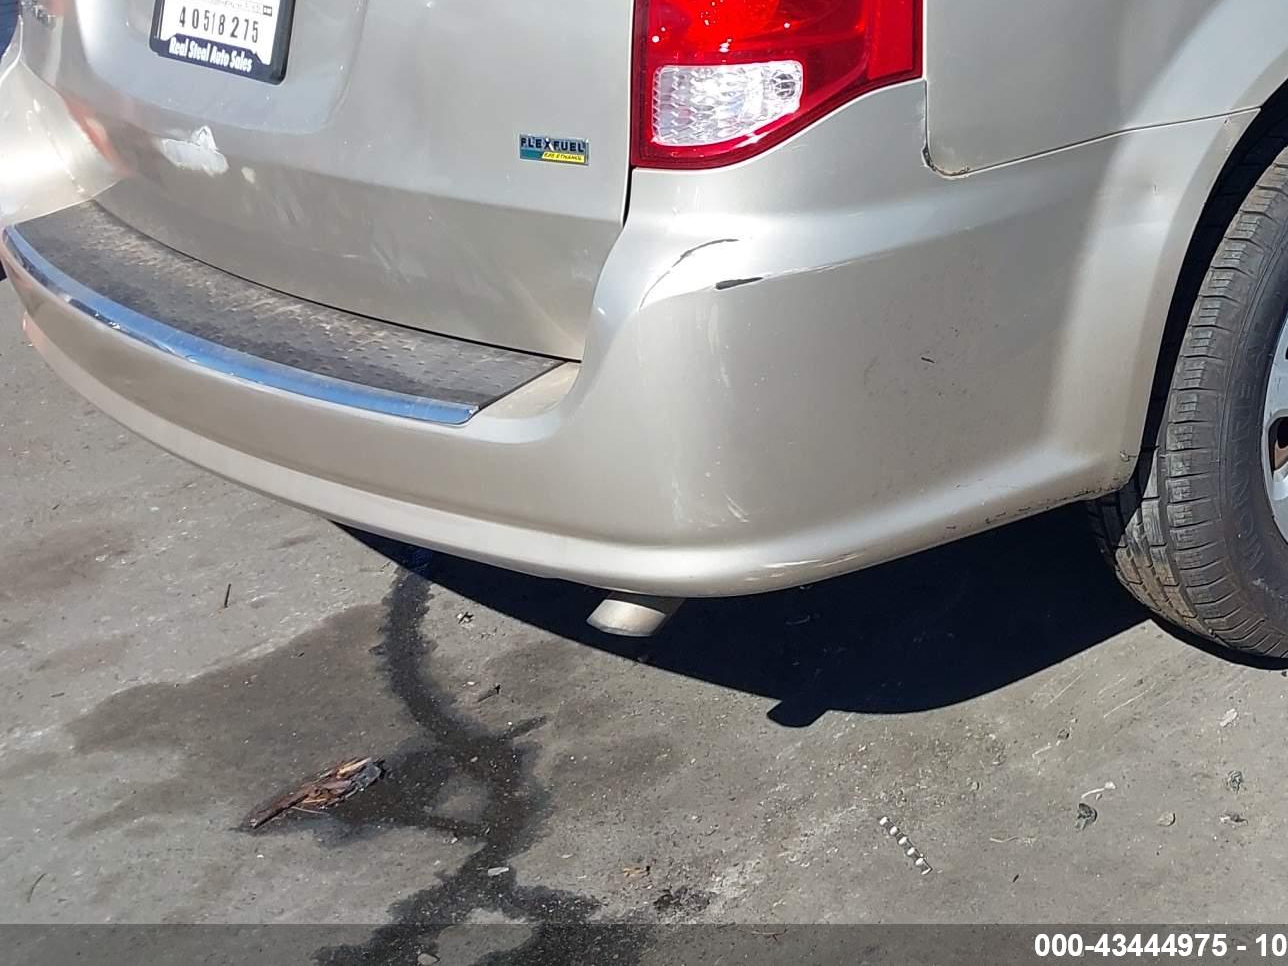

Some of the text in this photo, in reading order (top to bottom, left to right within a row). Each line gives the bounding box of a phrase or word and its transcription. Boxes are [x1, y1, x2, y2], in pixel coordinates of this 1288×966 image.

[168, 36, 253, 73] Real Steal Auto Sales
